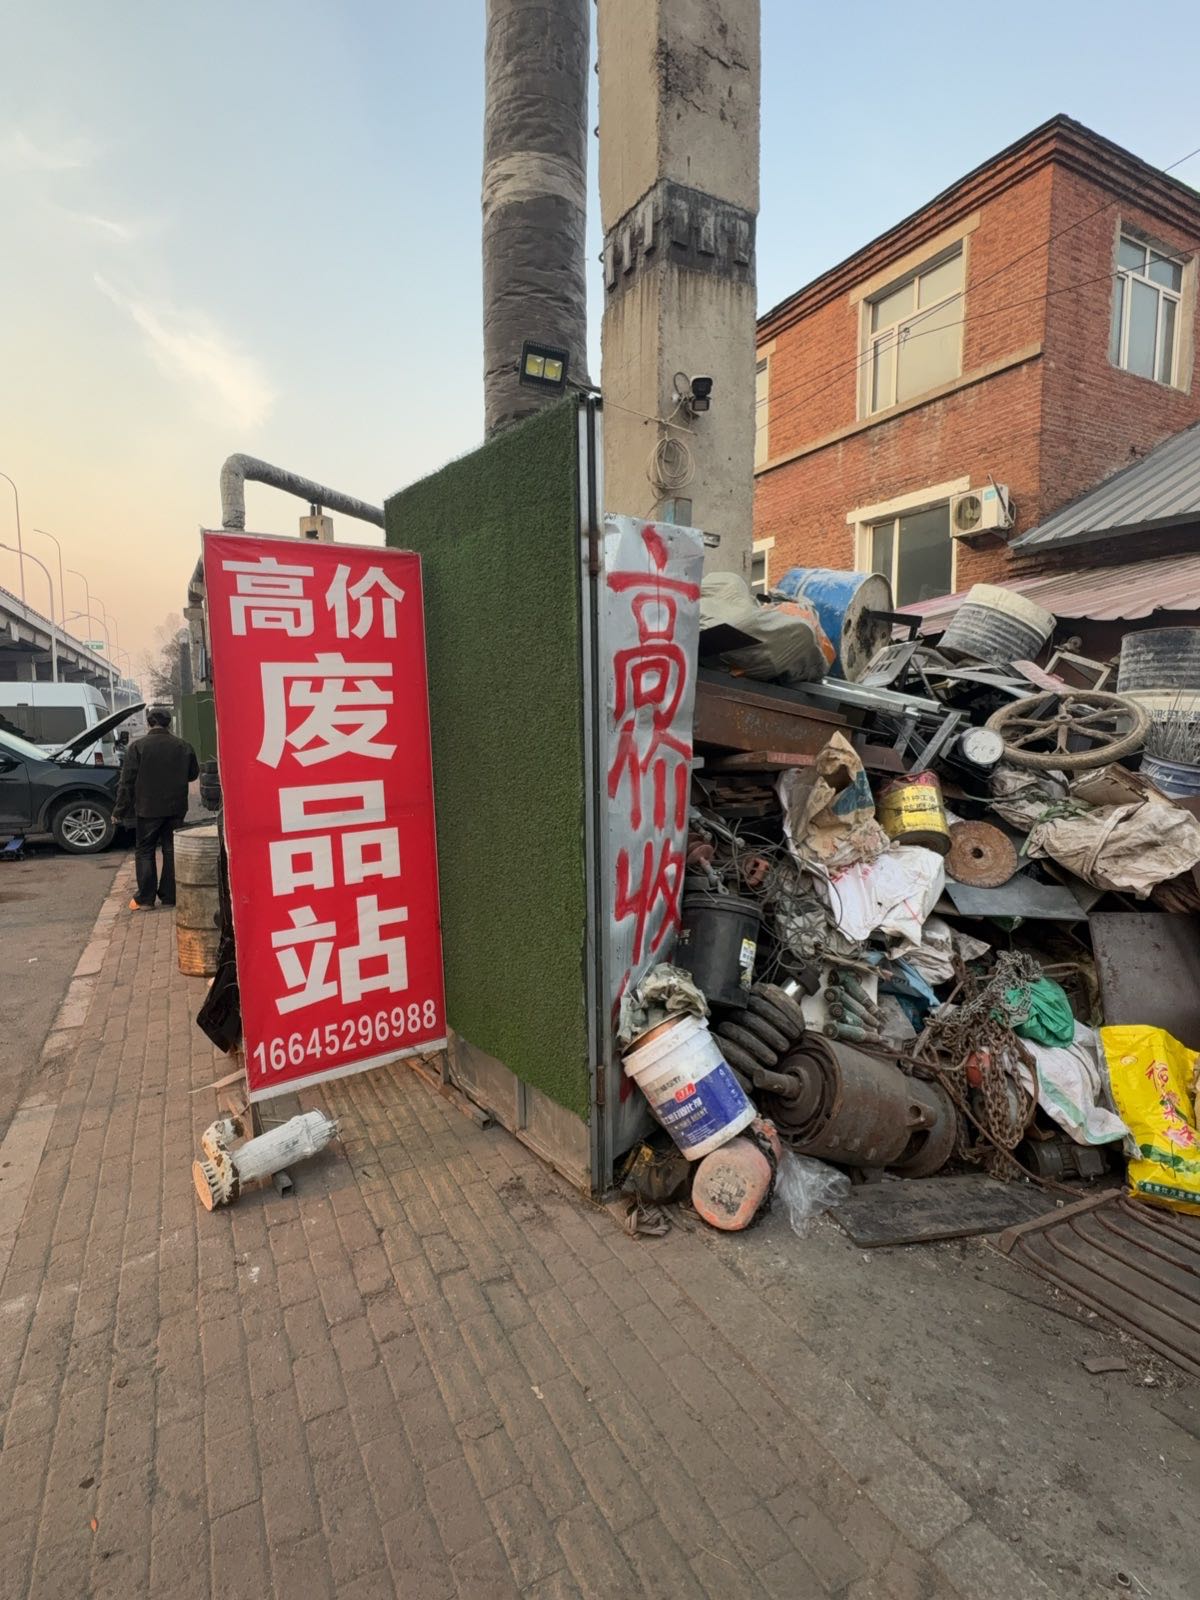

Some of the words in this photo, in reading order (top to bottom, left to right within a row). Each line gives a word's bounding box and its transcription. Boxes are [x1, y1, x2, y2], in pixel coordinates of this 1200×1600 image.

[222, 556, 405, 640] 高价
[256, 652, 409, 1016] 废品站
[606, 524, 700, 1030] 高价收
[253, 999, 437, 1075] 16645296988
